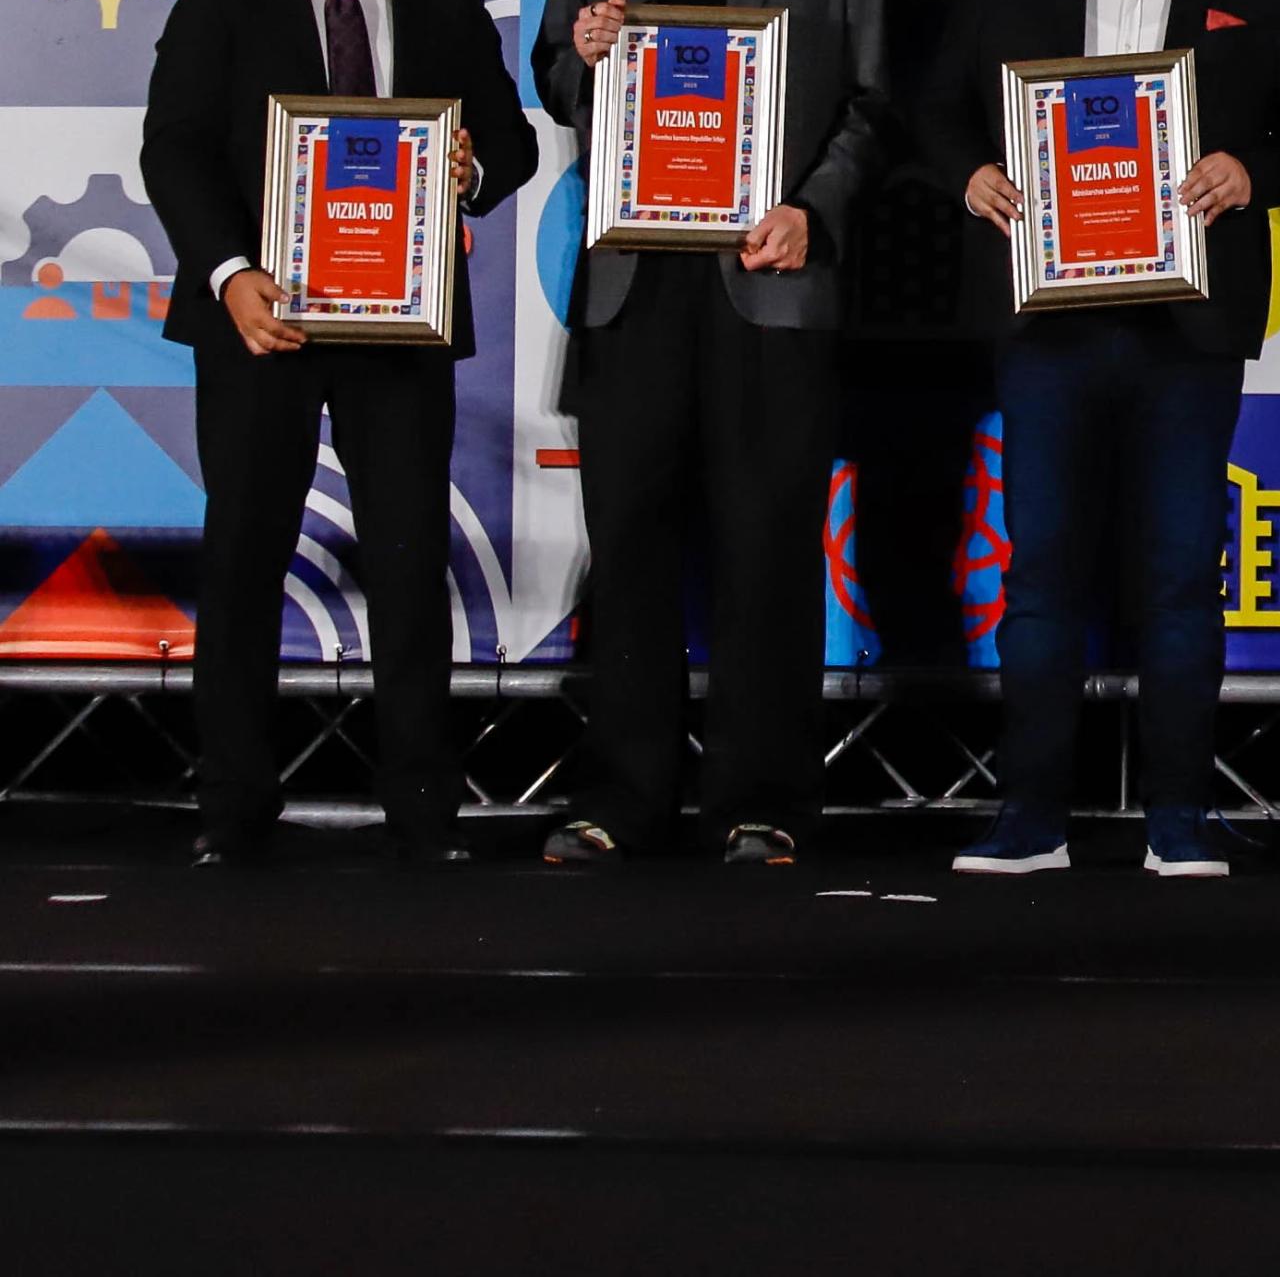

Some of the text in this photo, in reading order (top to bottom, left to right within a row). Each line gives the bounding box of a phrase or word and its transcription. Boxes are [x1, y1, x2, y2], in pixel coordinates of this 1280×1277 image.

[656, 110, 722, 128] VIZIJA 100
[1071, 160, 1137, 182] VIZIJA 100
[327, 201, 393, 220] VIZIJA 100
